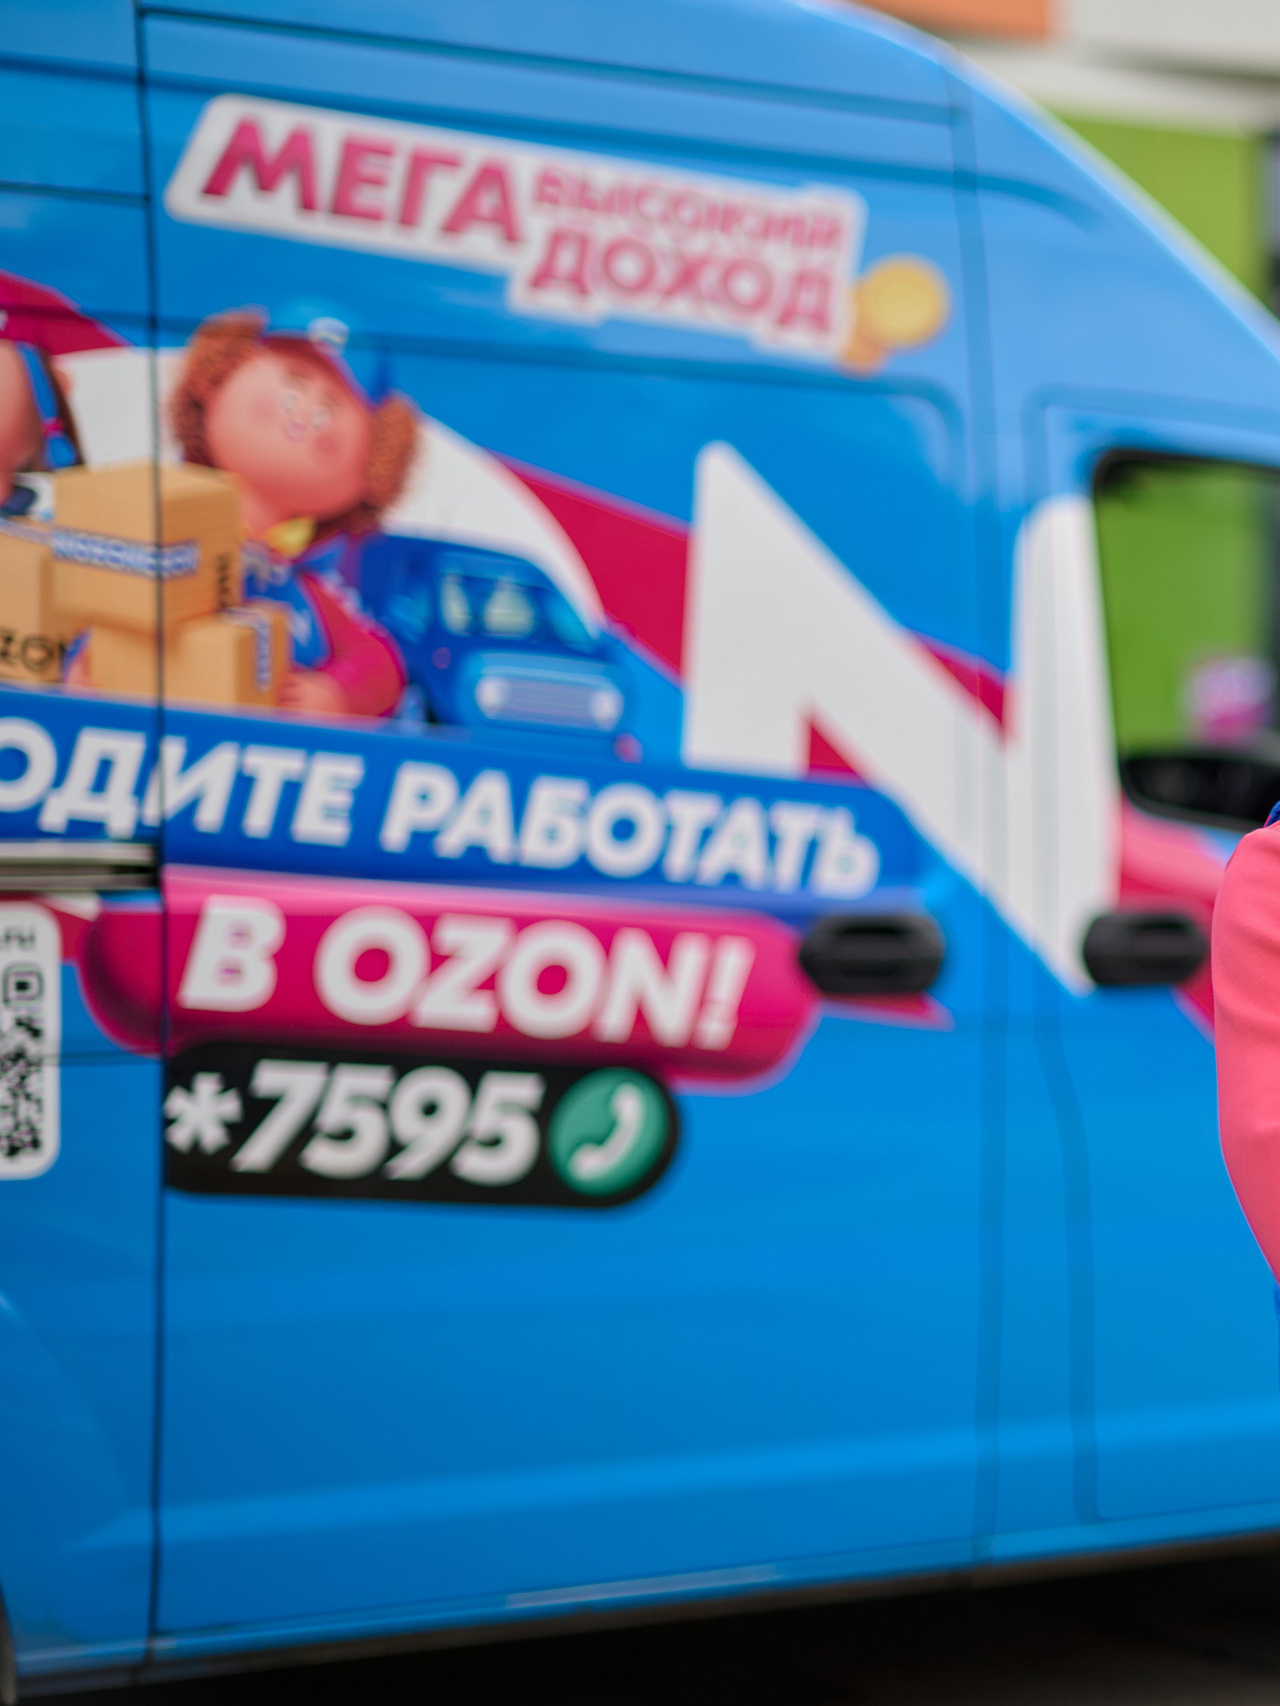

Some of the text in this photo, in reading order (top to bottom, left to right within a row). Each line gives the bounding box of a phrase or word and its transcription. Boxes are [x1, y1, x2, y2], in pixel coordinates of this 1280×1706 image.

[202, 118, 523, 245] МЕГА
[534, 170, 845, 250] ВЫСОКИЙ
[528, 228, 838, 336] ДОХОД
[380, 762, 882, 900] РАБОТАТЬ
[312, 905, 756, 1051] OZON!
